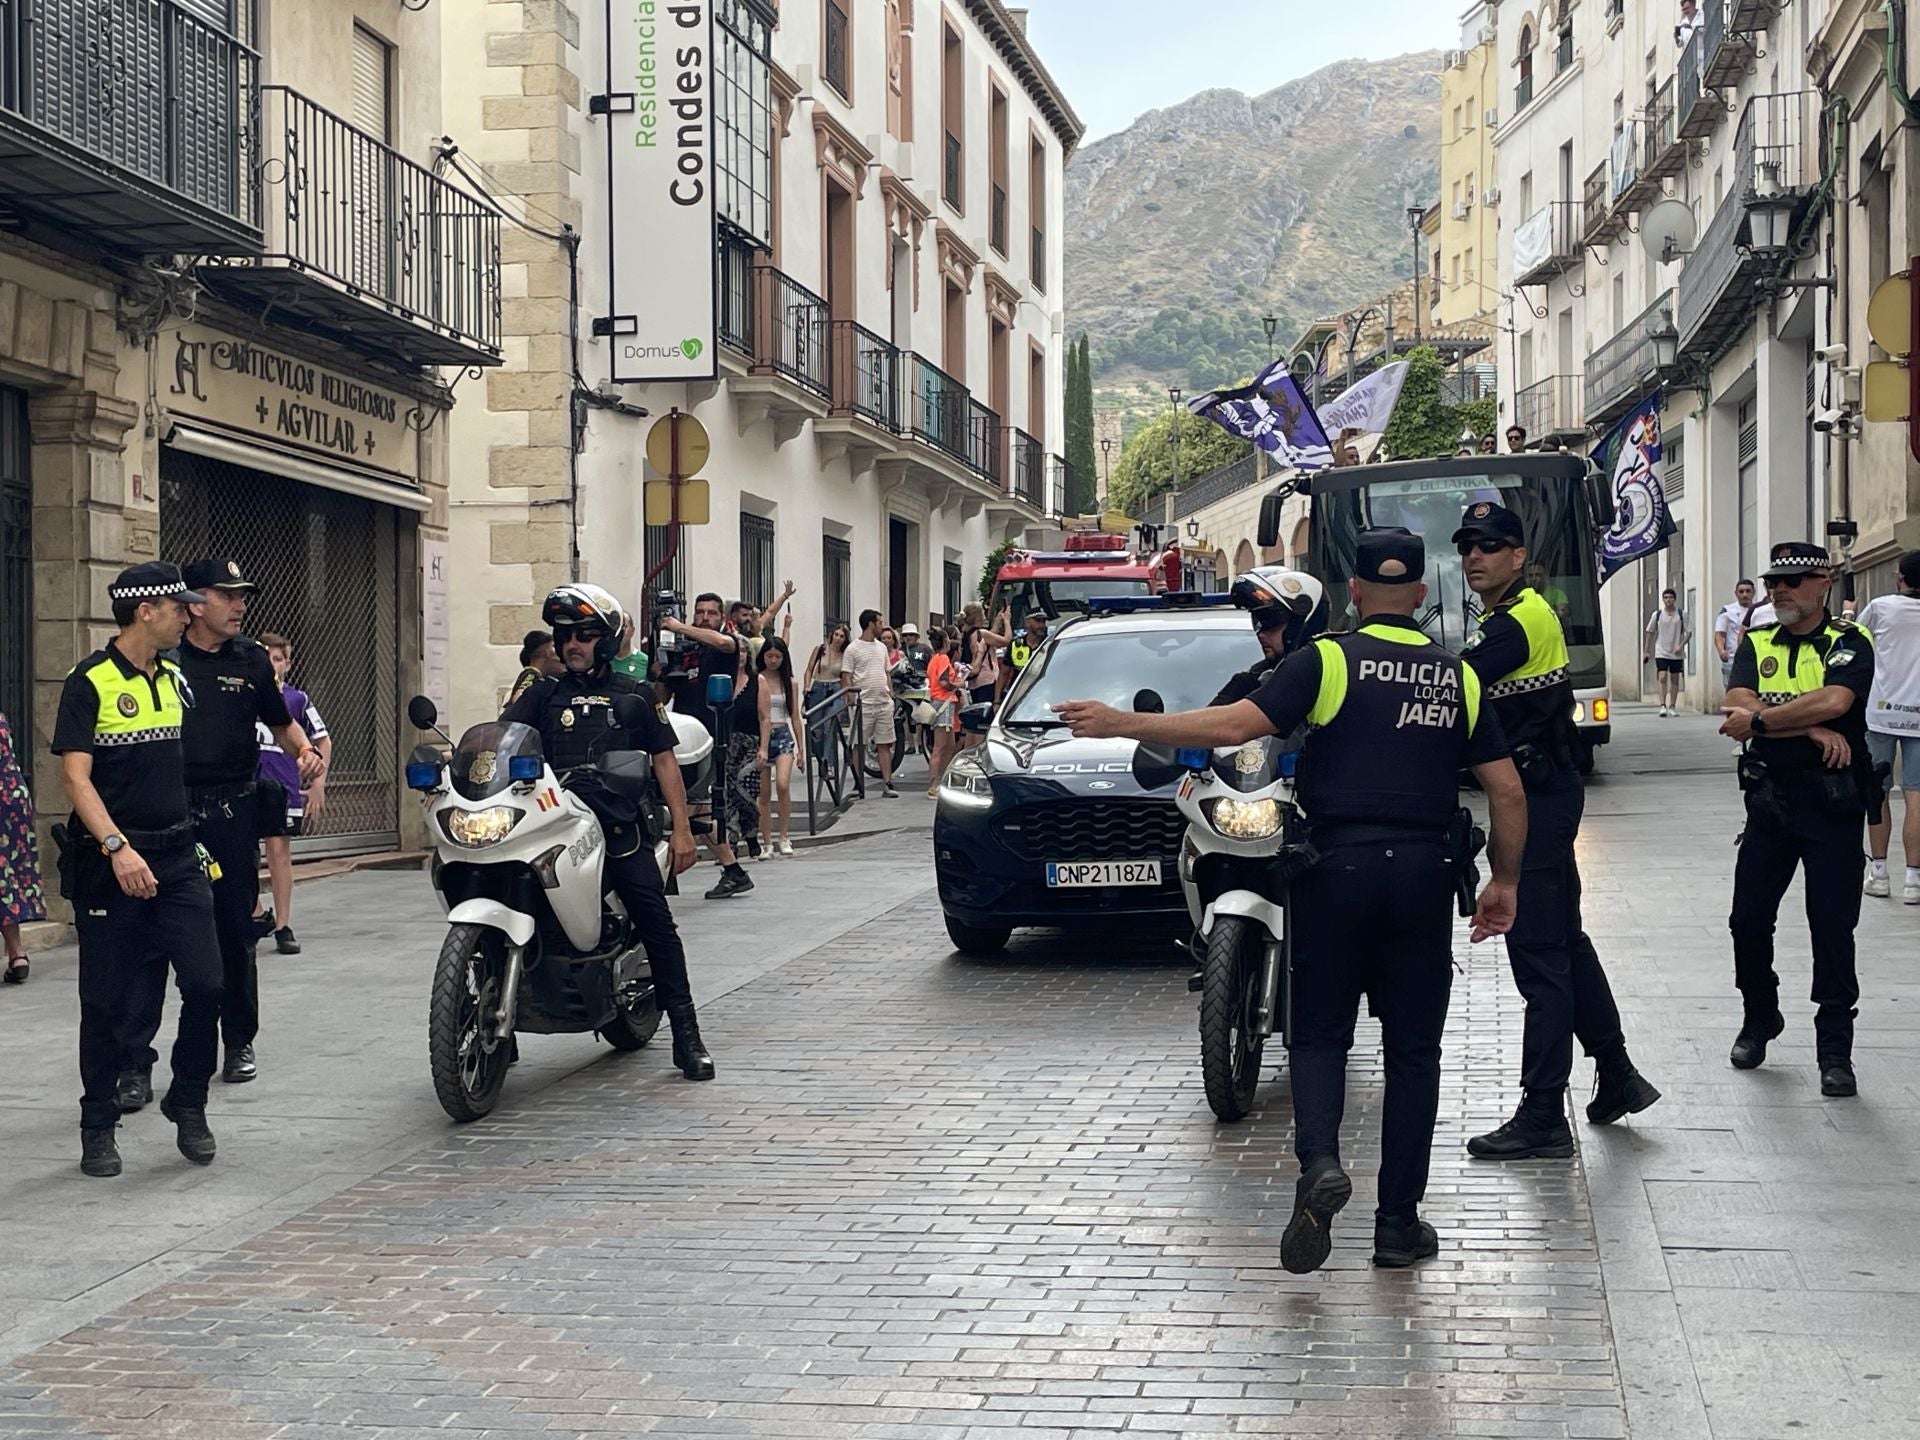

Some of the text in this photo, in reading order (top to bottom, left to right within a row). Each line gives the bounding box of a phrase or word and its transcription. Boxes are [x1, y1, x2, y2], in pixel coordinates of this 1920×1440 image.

[667, 0, 703, 206] Condes d
[624, 345, 680, 358] Domus
[277, 399, 358, 454] AGVILAR
[1359, 660, 1458, 688] POLICÍA
[1415, 686, 1459, 702] LOCAL
[1396, 700, 1458, 728] JAÉN
[1030, 763, 1132, 774] POLICI
[1057, 864, 1157, 884] CNP2118ZA
